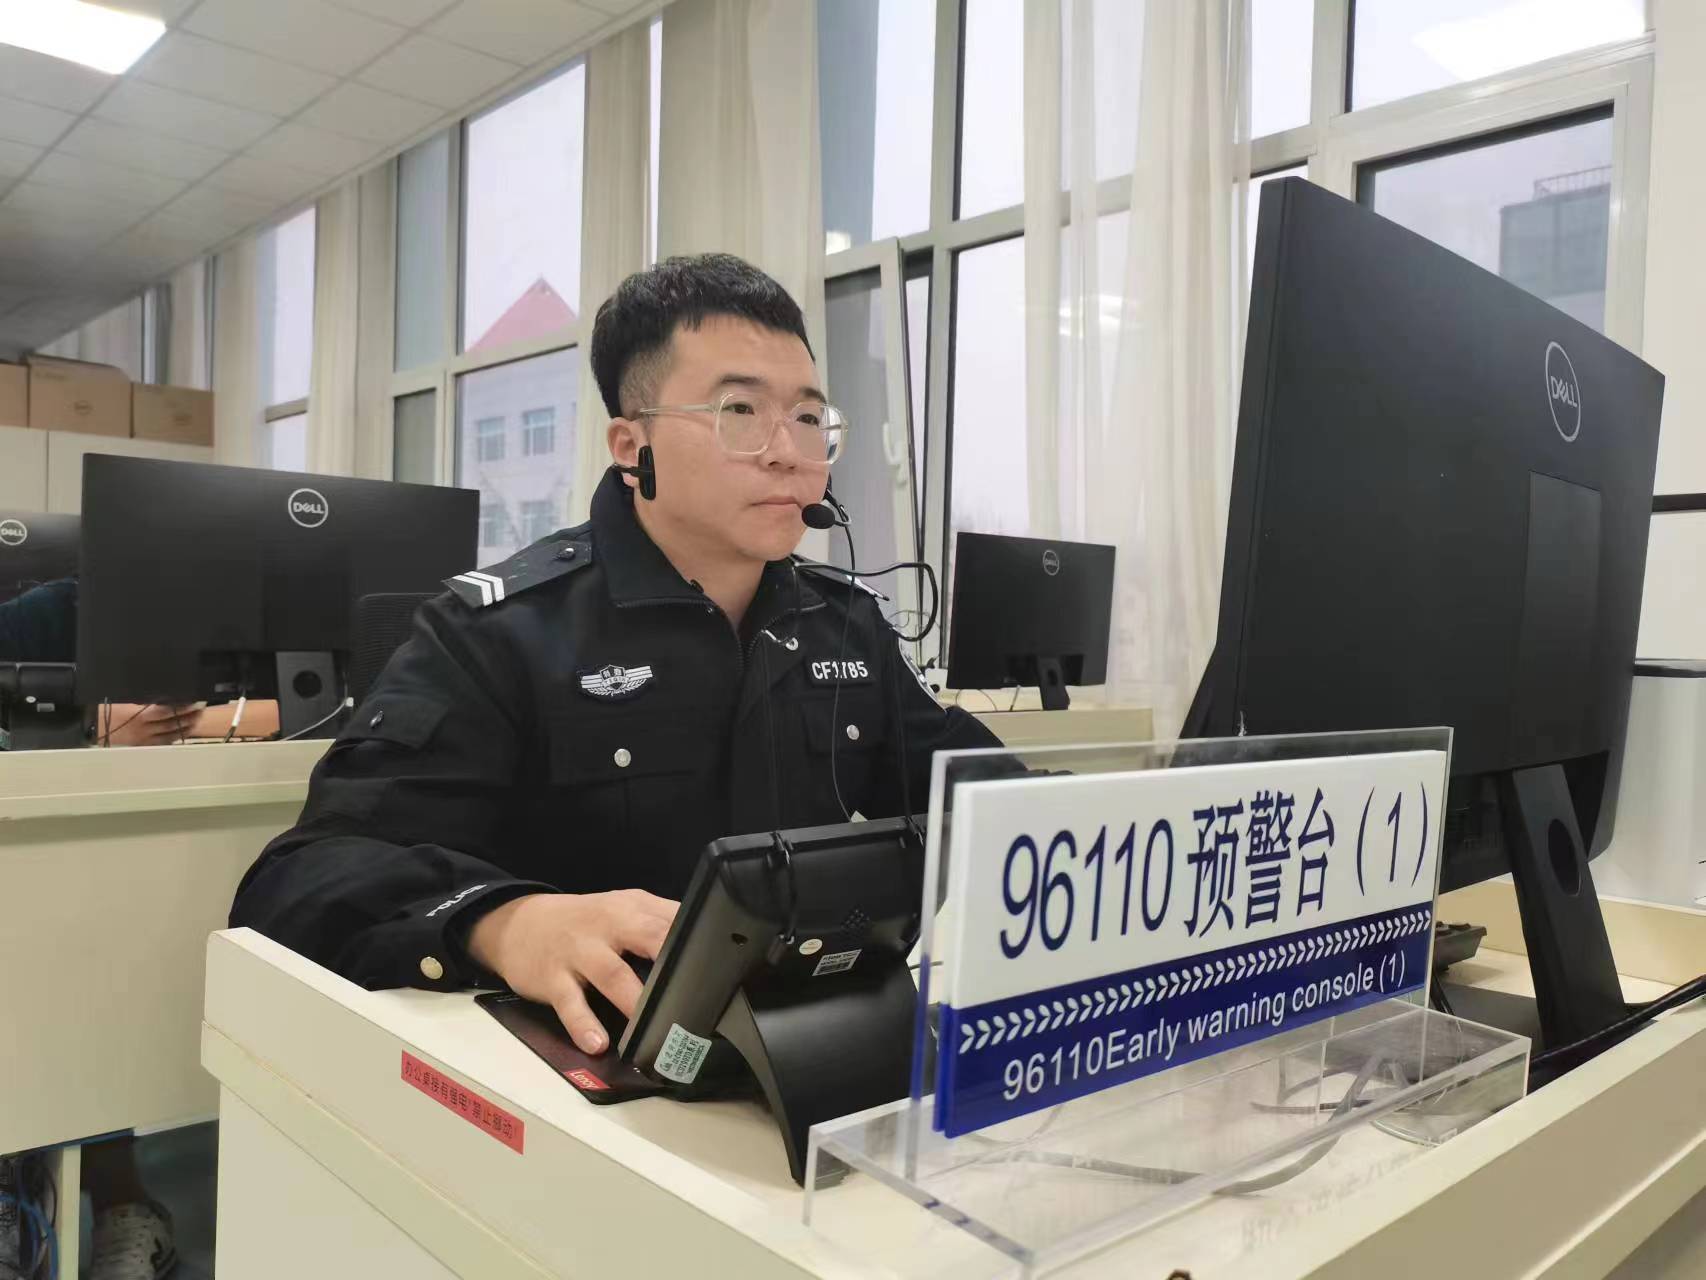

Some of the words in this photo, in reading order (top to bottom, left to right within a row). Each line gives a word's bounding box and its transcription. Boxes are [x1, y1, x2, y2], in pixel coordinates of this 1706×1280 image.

[1550, 376, 1577, 408] DELL
[293, 502, 324, 514] DELL
[1003, 1022, 1182, 1102] 96110Early
[1187, 991, 1286, 1044] warning
[1292, 963, 1374, 1010] console
[1379, 951, 1406, 992] (1)
